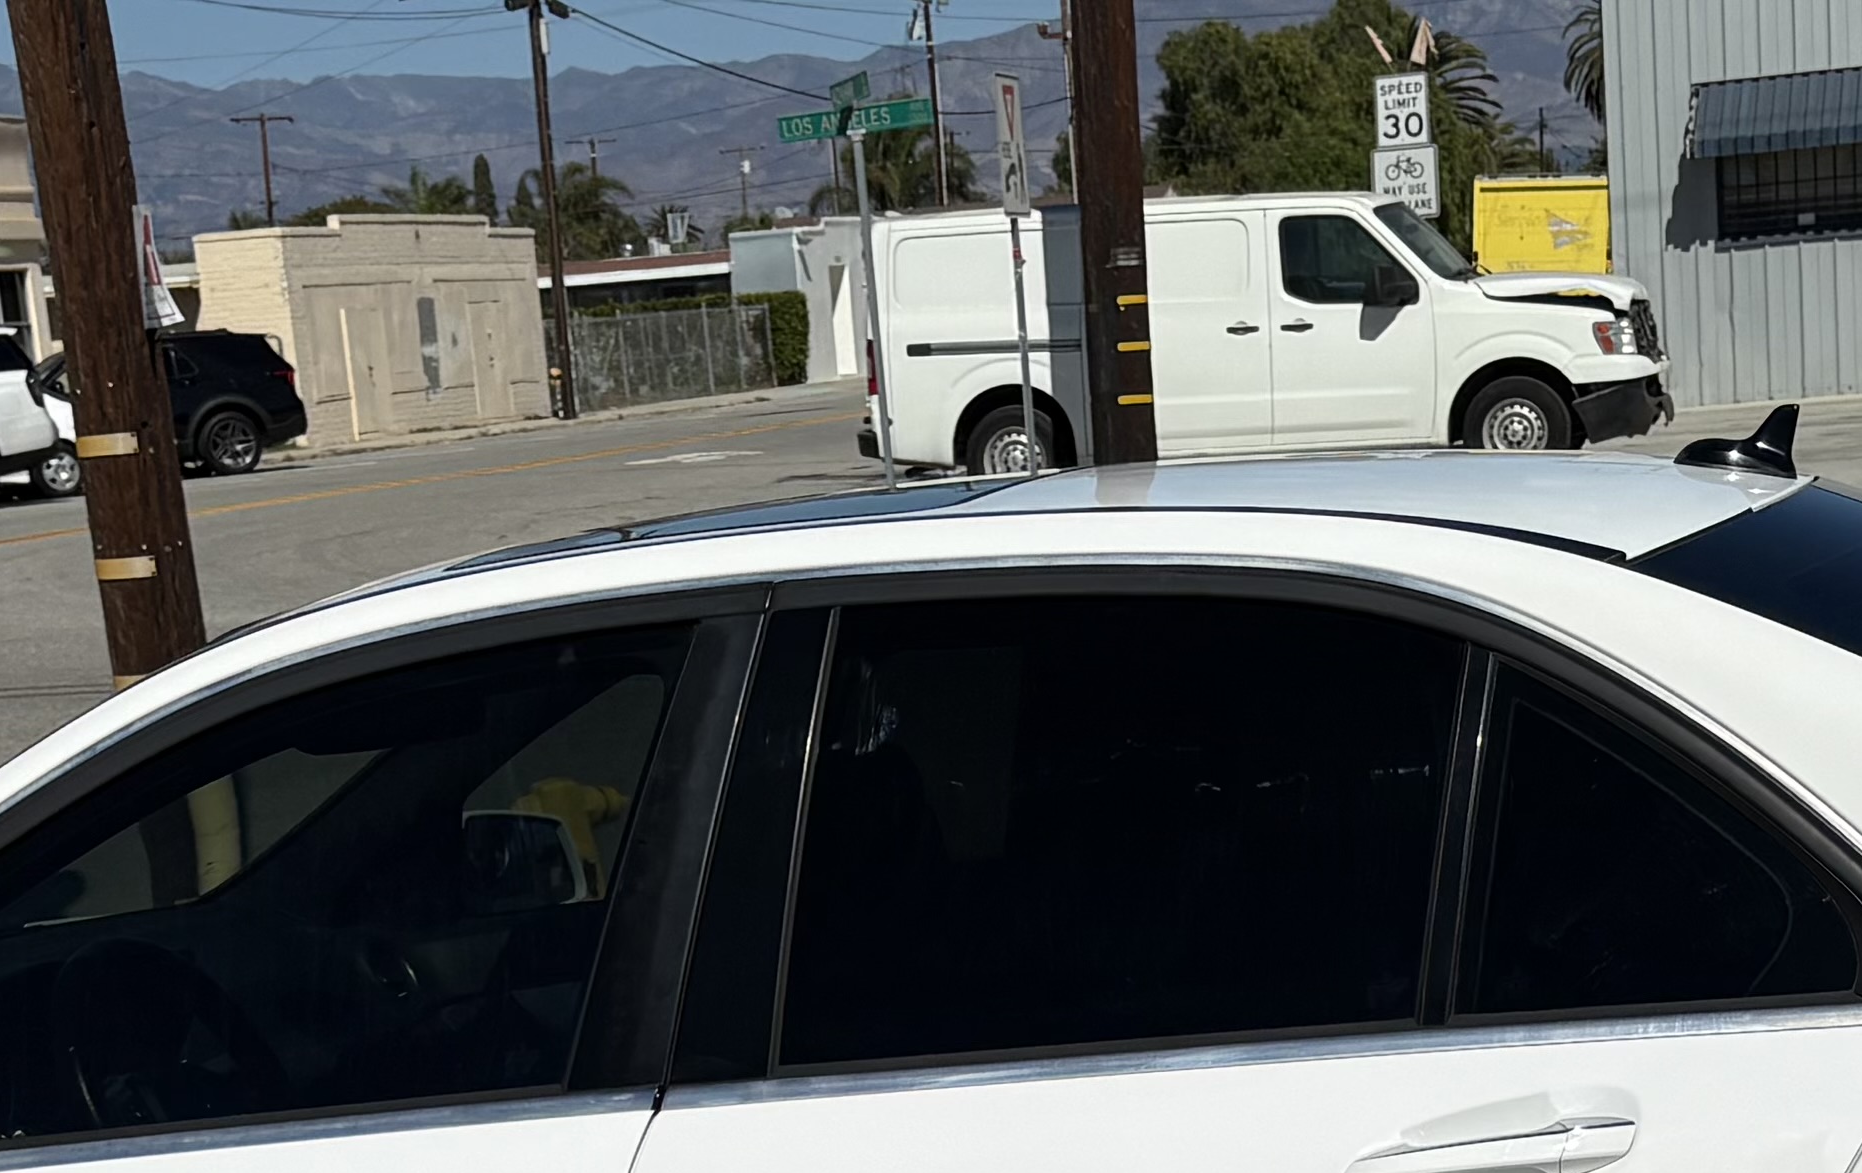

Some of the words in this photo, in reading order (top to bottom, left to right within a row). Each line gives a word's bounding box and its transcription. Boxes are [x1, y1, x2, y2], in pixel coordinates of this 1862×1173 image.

[1379, 82, 1423, 97] SPEED
[1384, 97, 1418, 110] LIMIT
[782, 118, 813, 137] LOS
[1383, 112, 1423, 139] 30
[1408, 182, 1427, 195] USE
